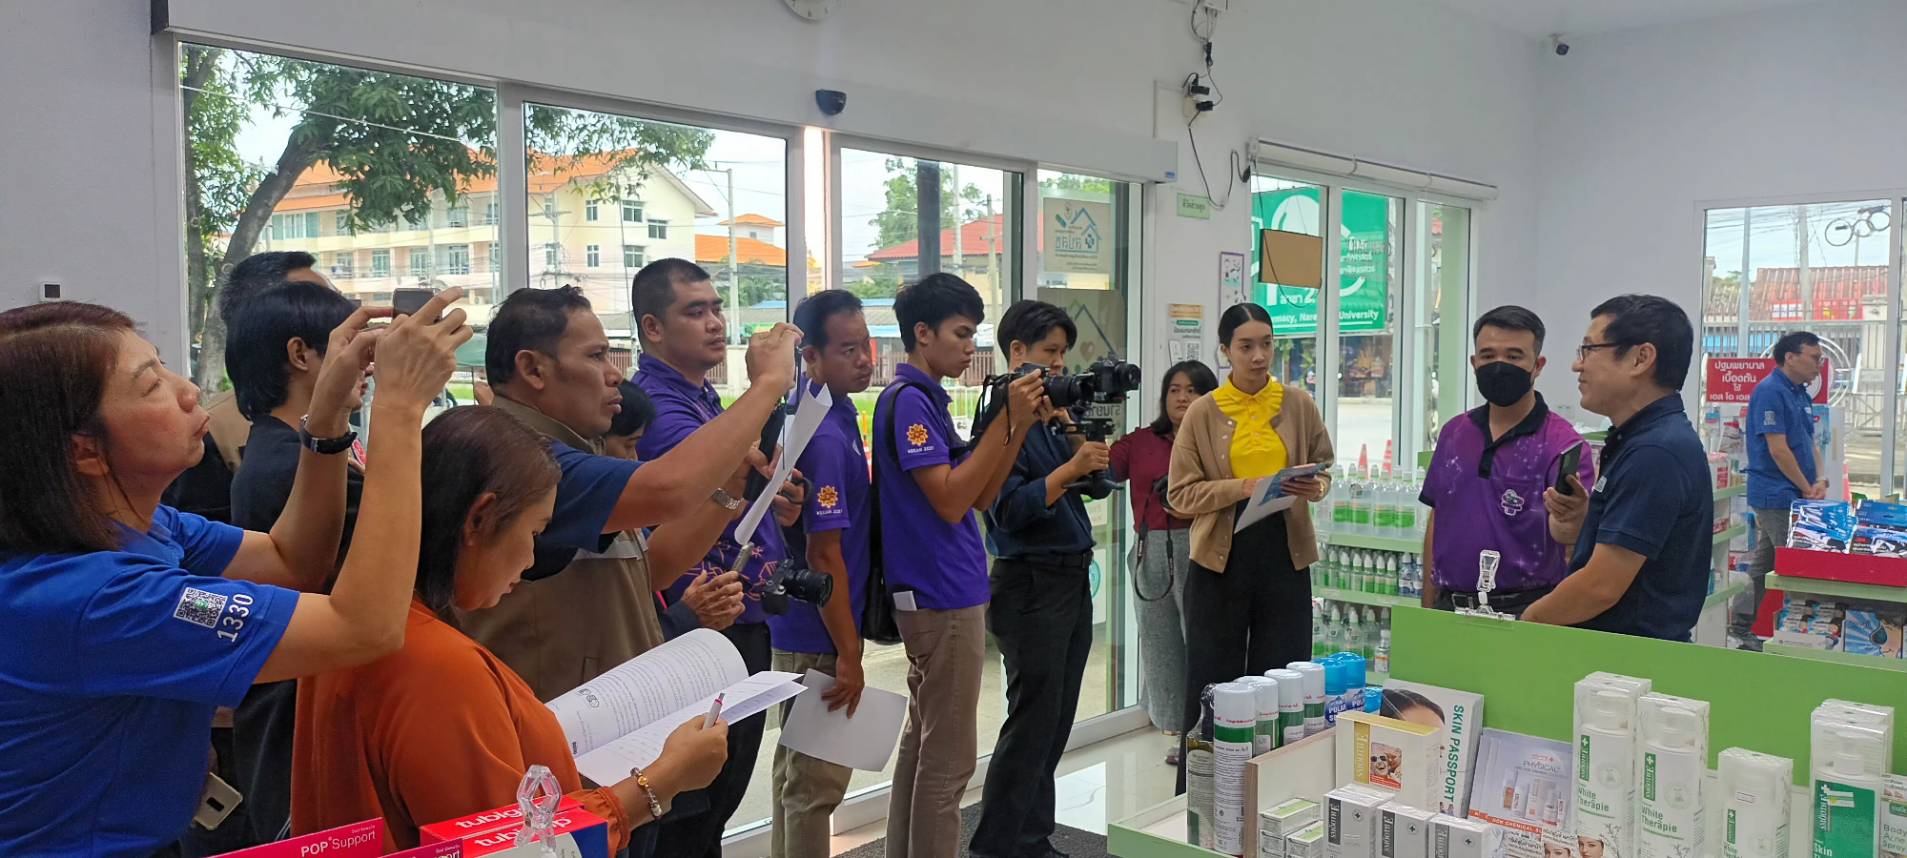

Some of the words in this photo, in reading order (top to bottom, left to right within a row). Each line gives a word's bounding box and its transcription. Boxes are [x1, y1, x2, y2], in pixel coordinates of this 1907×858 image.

[1339, 310, 1379, 321] University
[1714, 361, 1765, 372] ปฐมพยาบาล
[217, 593, 254, 643] 1330
[1450, 704, 1465, 735] SKIN
[1443, 737, 1460, 802] PASSPORT
[1641, 805, 1663, 821] White
[332, 830, 376, 850] Support
